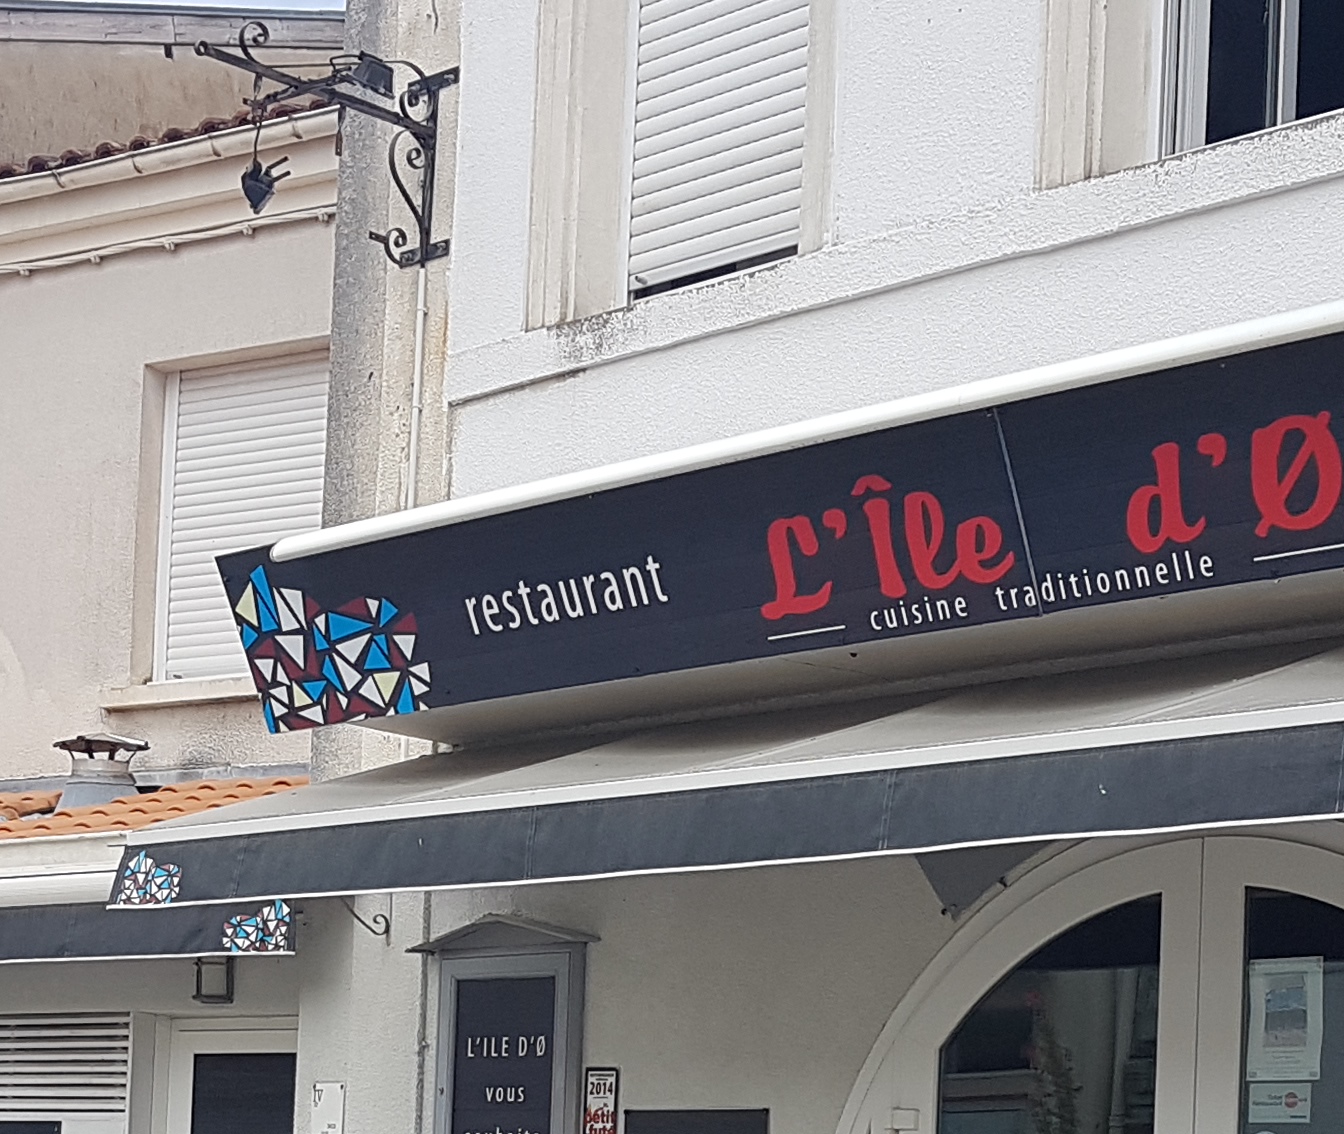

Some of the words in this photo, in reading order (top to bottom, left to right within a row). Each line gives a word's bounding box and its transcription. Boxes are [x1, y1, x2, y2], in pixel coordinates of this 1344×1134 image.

[464, 554, 670, 636] restaurant
[869, 595, 968, 632] cuisine
[995, 550, 1215, 612] traditionnelle
[485, 1086, 525, 1102] vous
[588, 1080, 614, 1096] 2014
